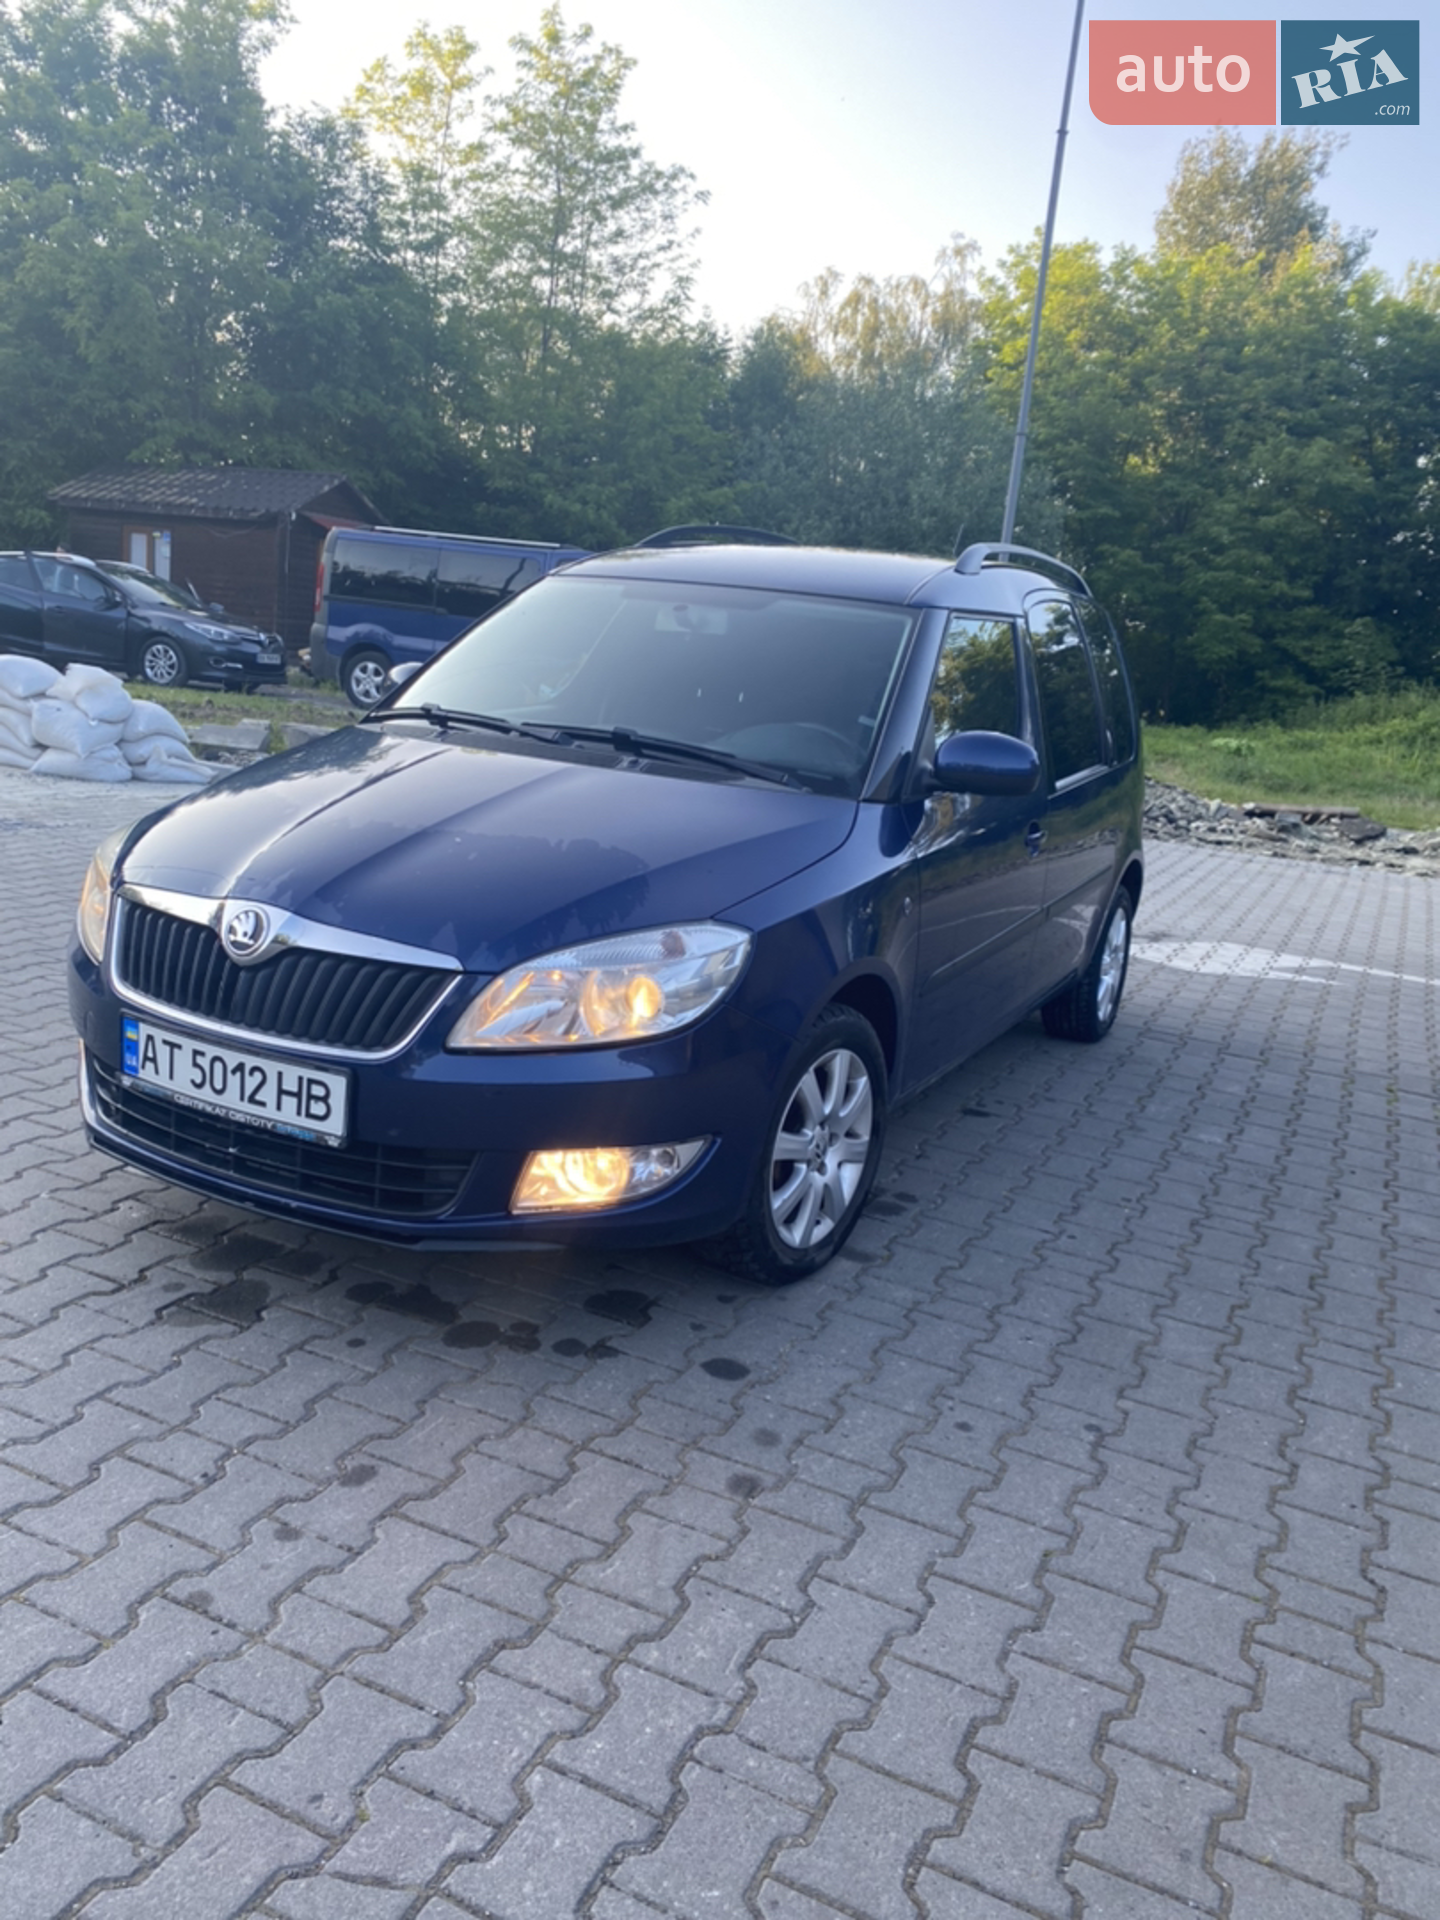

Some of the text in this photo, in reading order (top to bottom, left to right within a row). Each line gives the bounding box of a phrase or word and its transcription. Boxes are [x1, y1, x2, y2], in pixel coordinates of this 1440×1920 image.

[141, 1033, 332, 1123] AT 5012 HB
